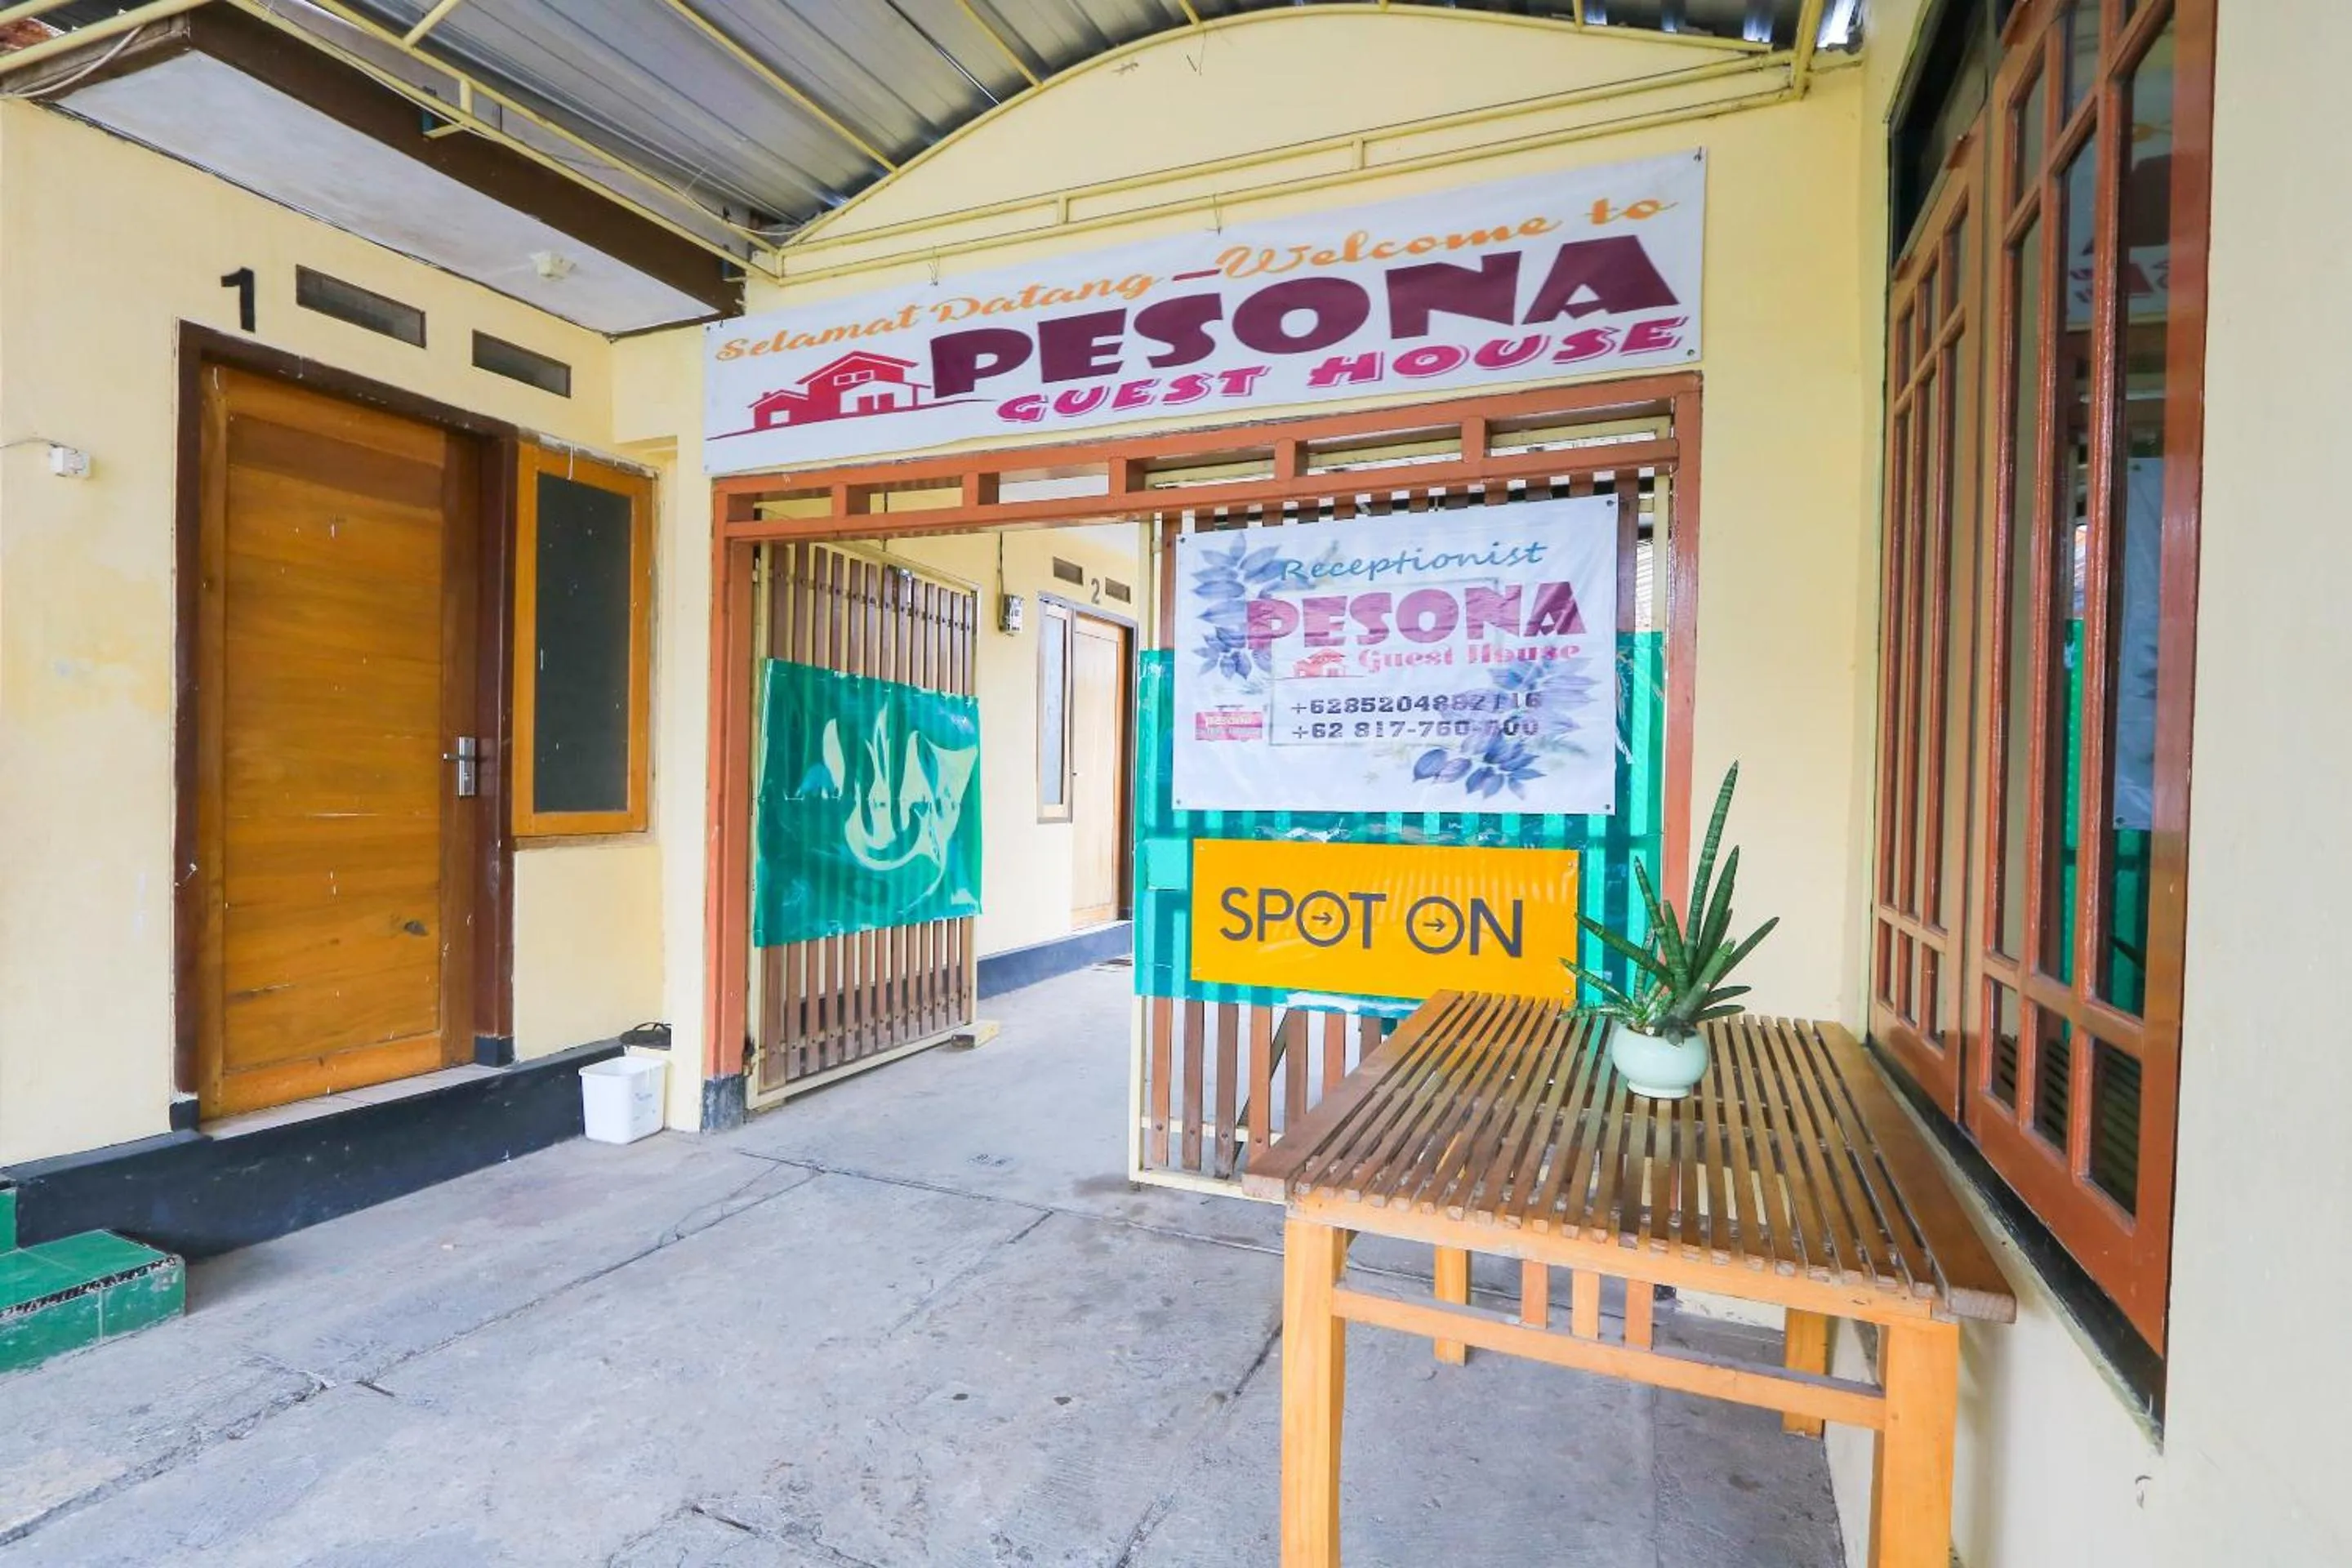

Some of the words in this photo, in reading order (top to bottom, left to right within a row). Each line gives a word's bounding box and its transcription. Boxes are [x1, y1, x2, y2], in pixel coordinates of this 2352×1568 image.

[220, 266, 256, 333] 1
[714, 303, 927, 362] Selamat
[929, 271, 1165, 323] Datang
[1216, 216, 1562, 278] Welcome
[1584, 198, 1677, 226] to
[929, 234, 1680, 399] PESONA
[996, 365, 1272, 423] GUEST
[1307, 315, 1688, 388] HOUSE
[1090, 577, 1100, 605] 2
[1280, 541, 1548, 581] Receptionist
[1245, 581, 1587, 651] PESONA
[1358, 646, 1453, 673] Guest
[1467, 644, 1580, 664] House
[1292, 721, 1344, 740] +62
[1219, 886, 1387, 950] SPOT
[1406, 896, 1523, 959] ON
